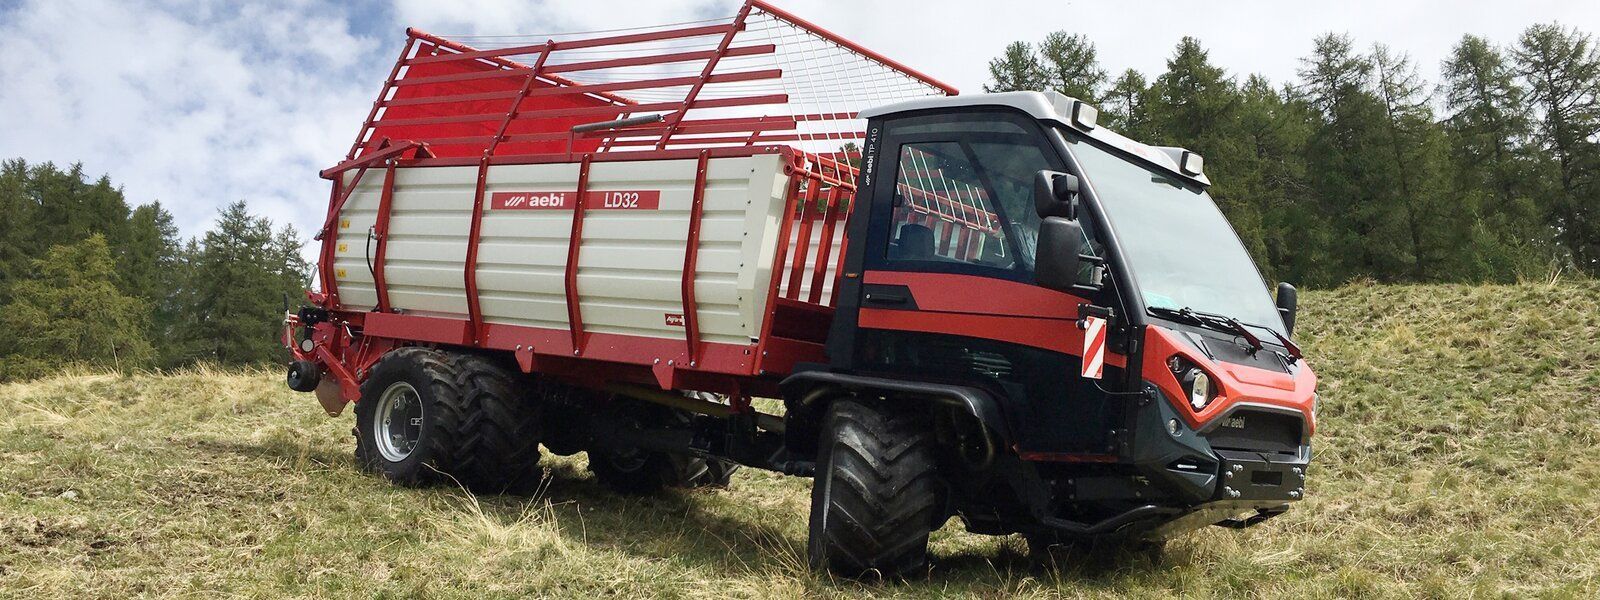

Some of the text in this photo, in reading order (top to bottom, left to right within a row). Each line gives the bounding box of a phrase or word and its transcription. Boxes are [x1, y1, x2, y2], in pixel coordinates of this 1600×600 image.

[869, 144, 875, 153] TP
[529, 194, 564, 207] aebi
[604, 192, 638, 208] LD32
[1231, 416, 1245, 428] aebi
